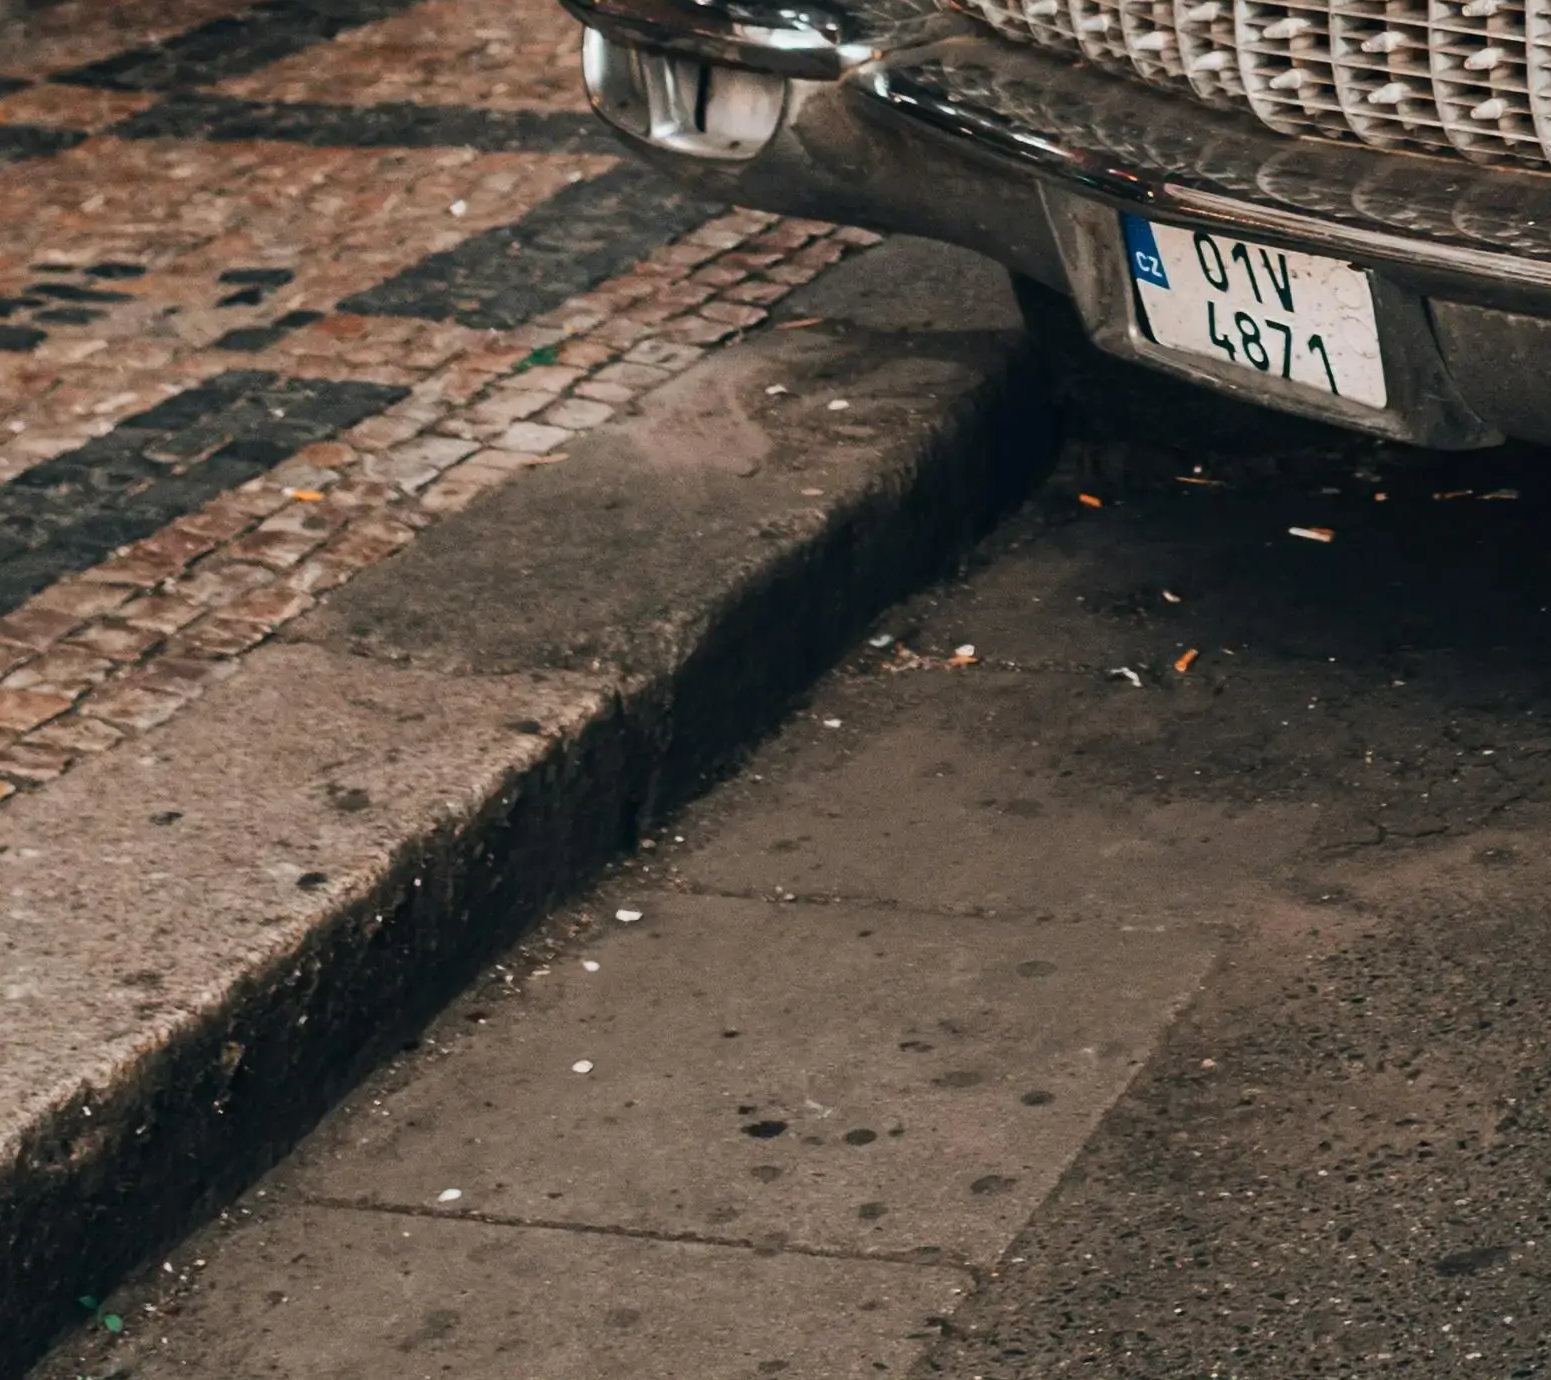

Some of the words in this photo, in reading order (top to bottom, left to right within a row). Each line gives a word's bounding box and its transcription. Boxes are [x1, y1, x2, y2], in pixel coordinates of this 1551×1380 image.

[1135, 250, 1164, 278] CZ
[1193, 230, 1295, 313] 01V
[1207, 300, 1341, 397] 4871
